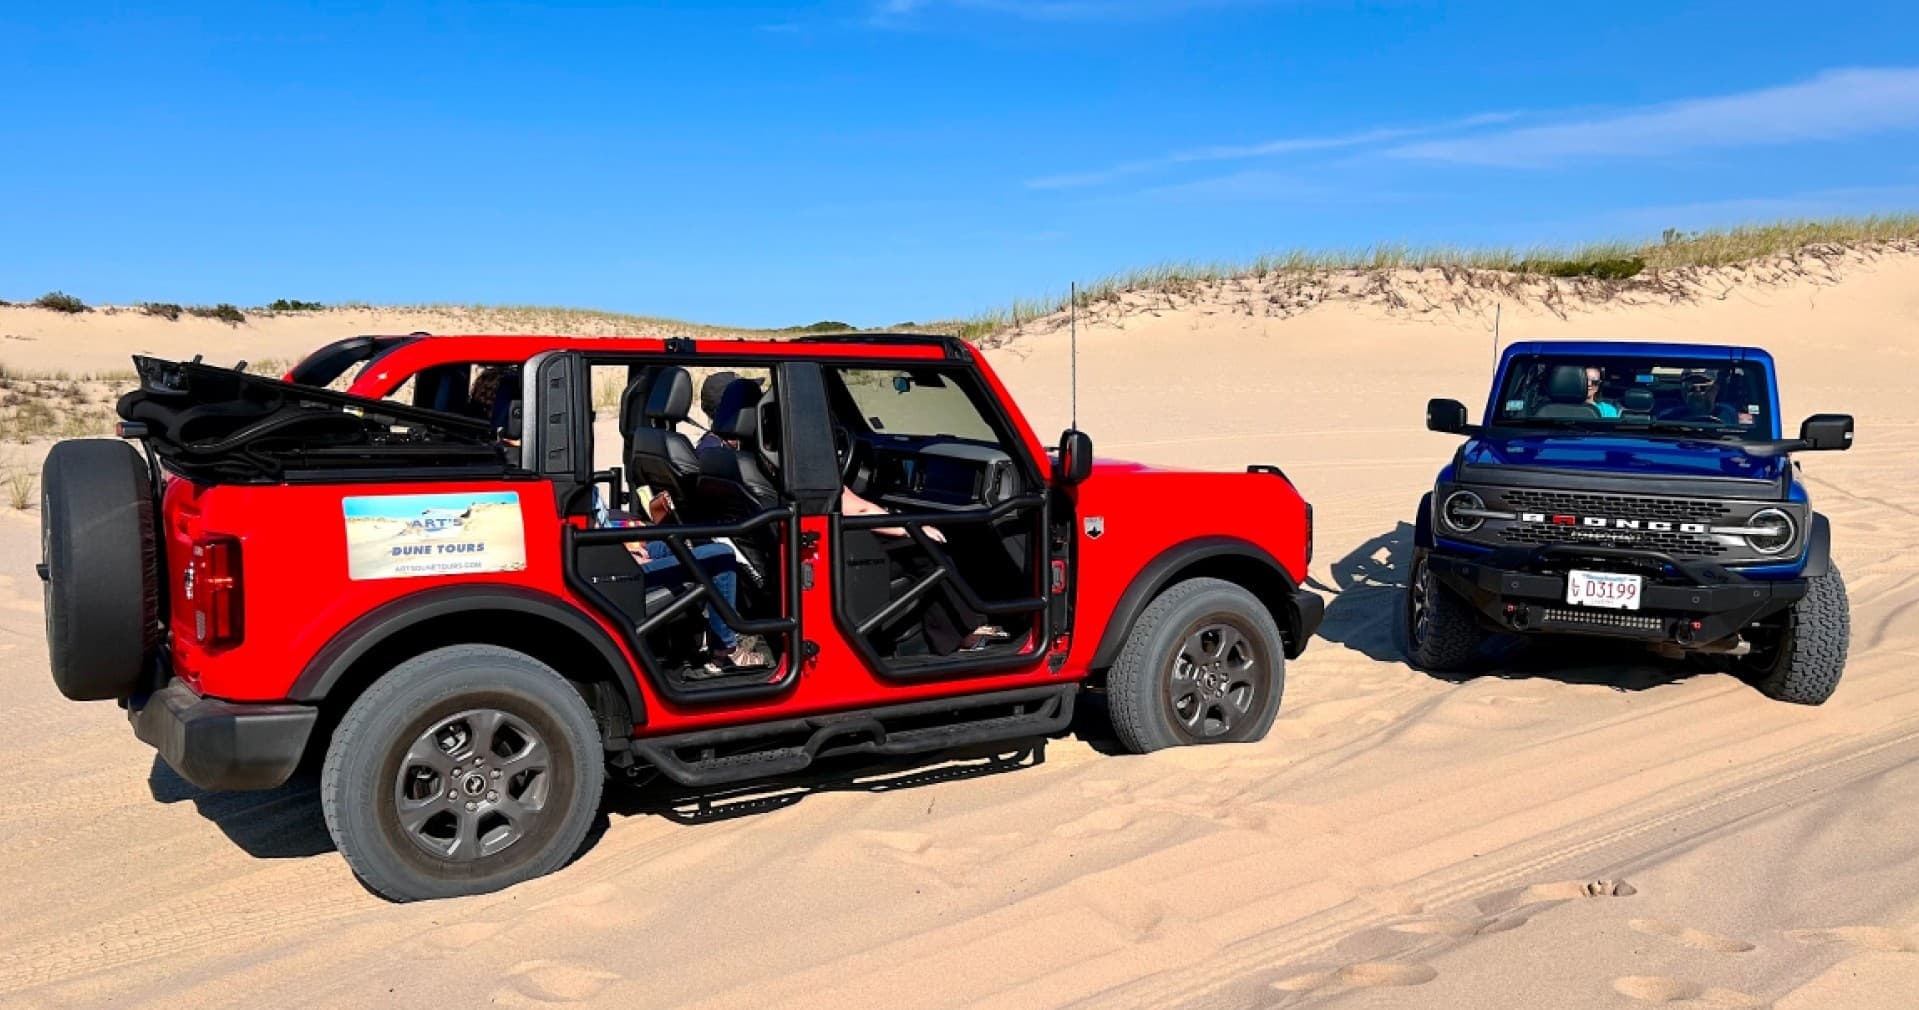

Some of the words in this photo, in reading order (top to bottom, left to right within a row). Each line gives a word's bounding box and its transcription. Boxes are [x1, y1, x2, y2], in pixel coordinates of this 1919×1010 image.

[411, 518, 463, 528] ART'S
[1522, 513, 1705, 533] BRONCO
[391, 545, 432, 557] DUNE
[436, 543, 485, 554] TOURS
[1586, 580, 1636, 600] D3199
